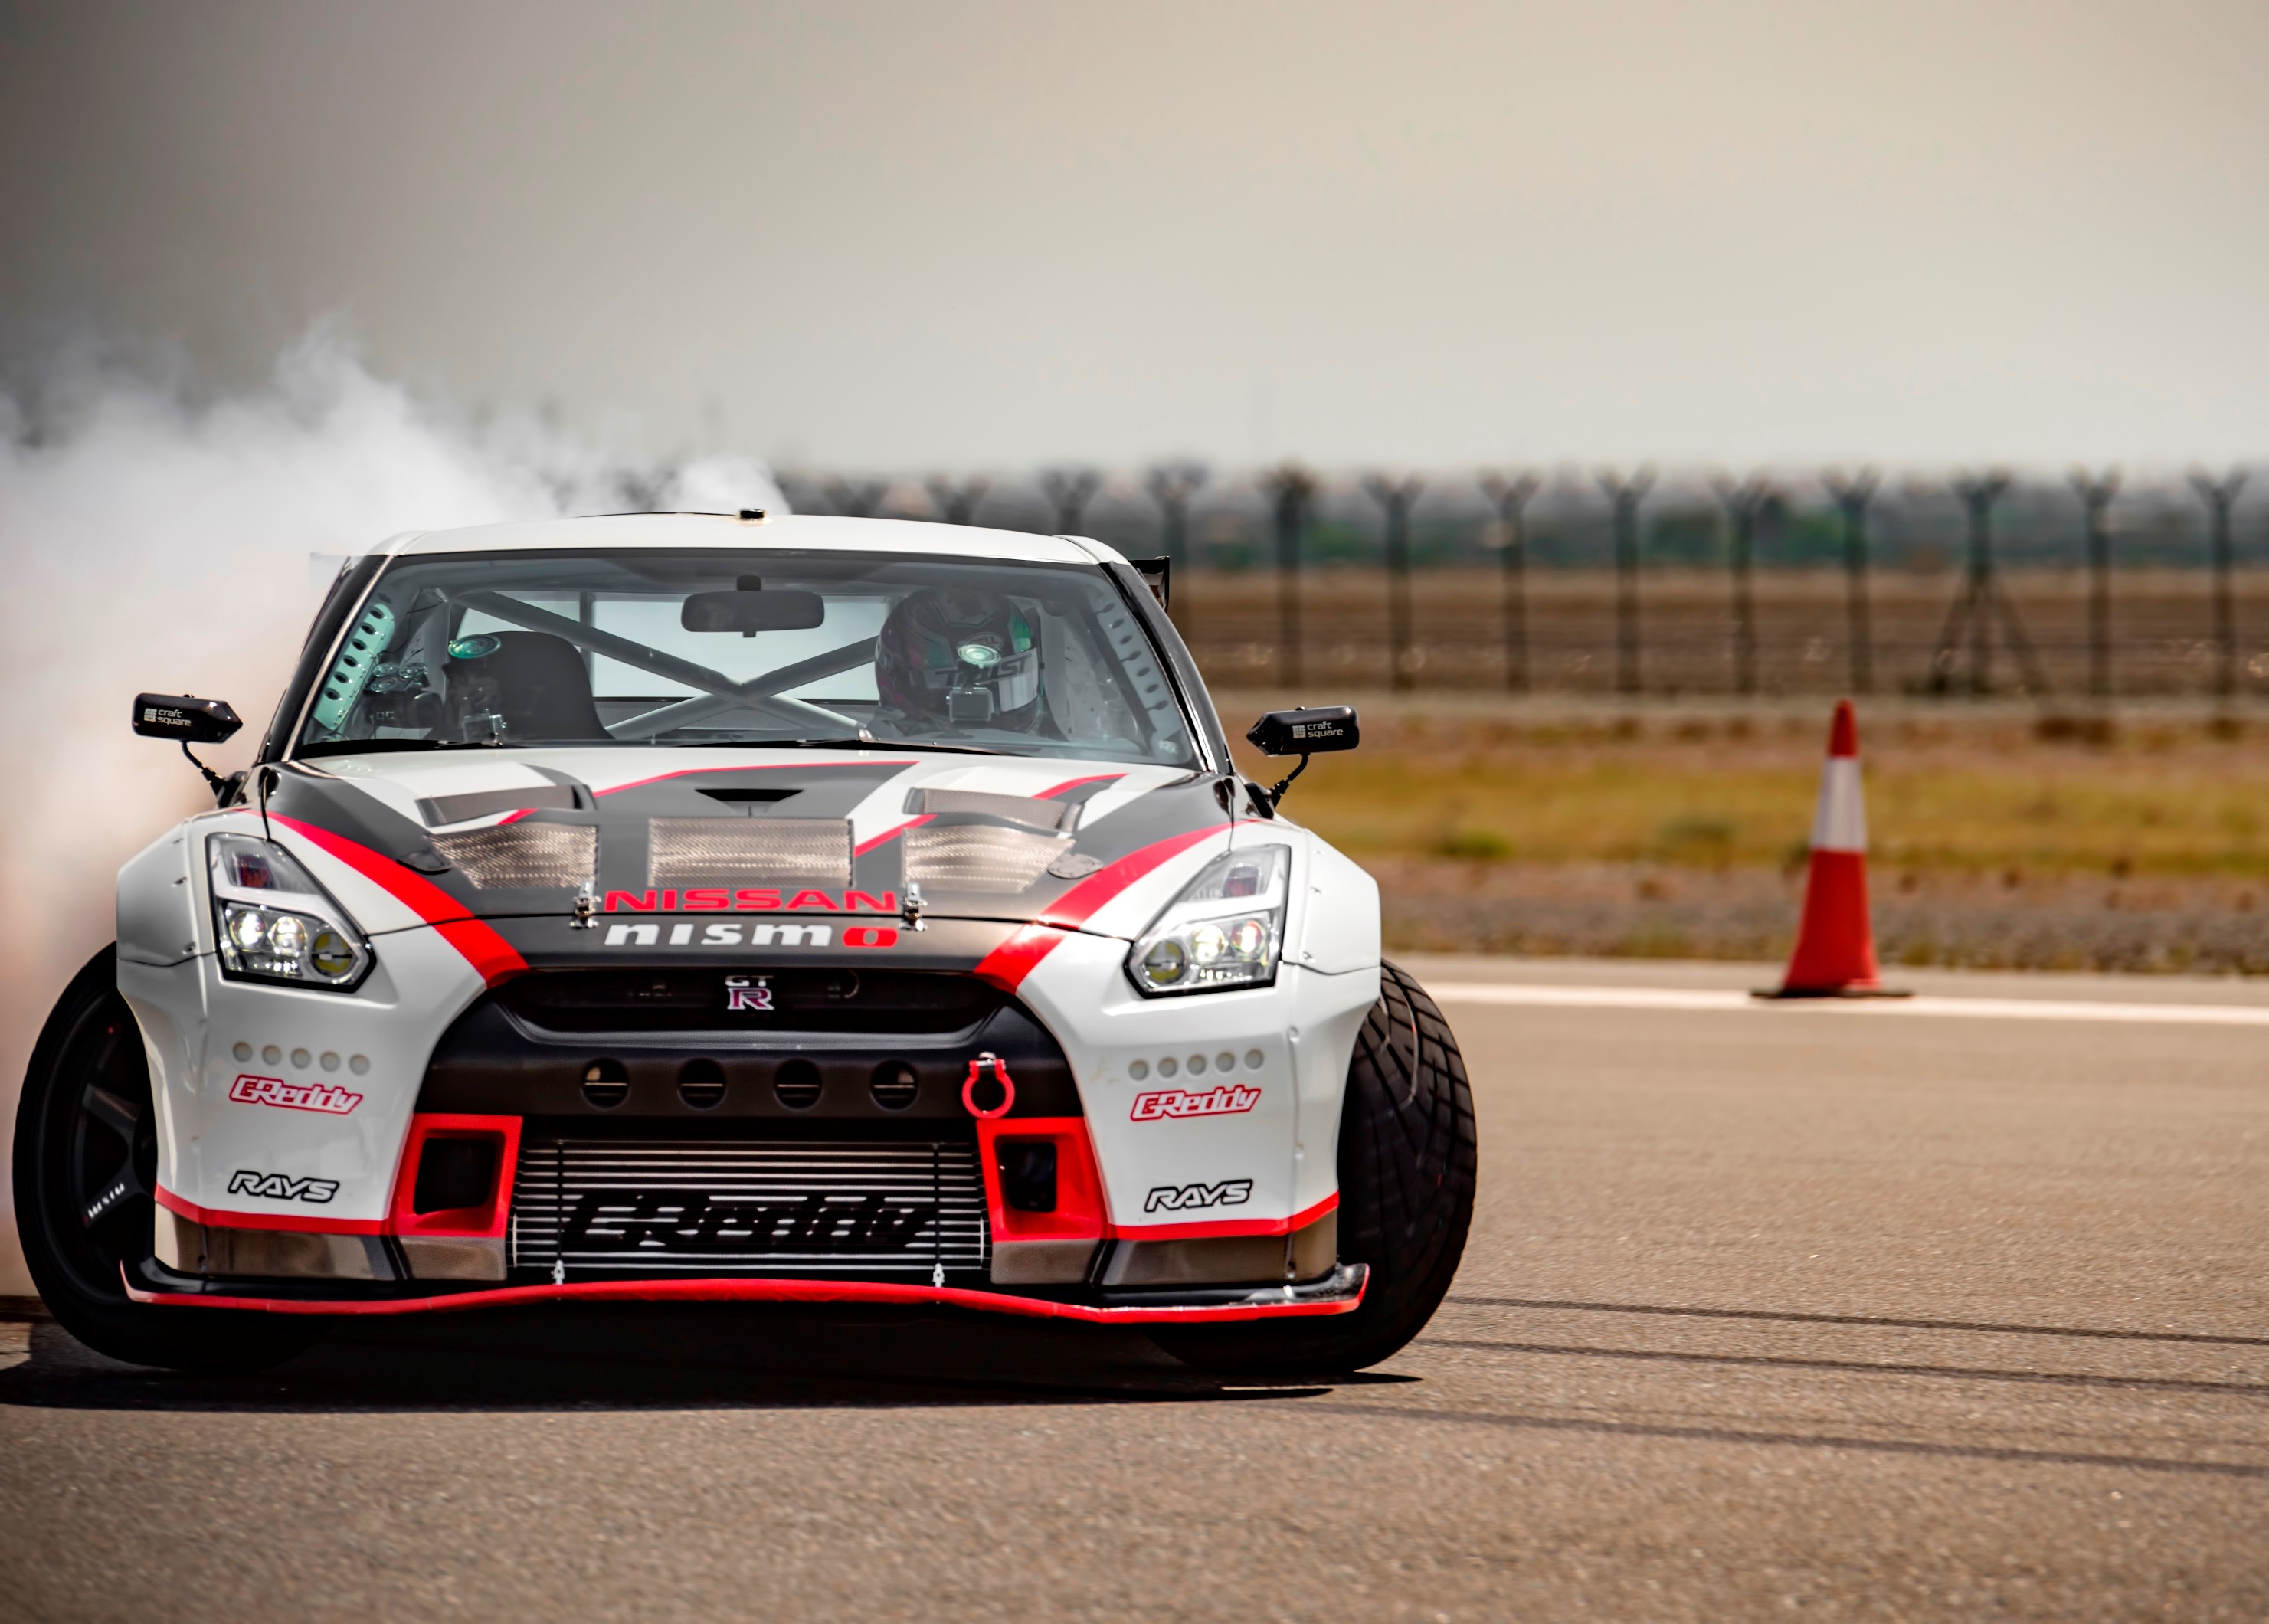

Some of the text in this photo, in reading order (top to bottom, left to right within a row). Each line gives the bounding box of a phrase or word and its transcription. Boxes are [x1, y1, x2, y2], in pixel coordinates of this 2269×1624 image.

[158, 709, 182, 718] craft
[158, 717, 191, 726] square
[1307, 721, 1331, 730] craft
[1308, 729, 1343, 738] square
[604, 889, 897, 912] NISSAN
[604, 923, 899, 948] nismo
[725, 975, 774, 987] GT
[726, 987, 775, 1010] R
[230, 1074, 363, 1115] GReddy
[1130, 1084, 1261, 1121] GReddy
[228, 1170, 340, 1203] RAYS
[1144, 1178, 1253, 1212] RAYS
